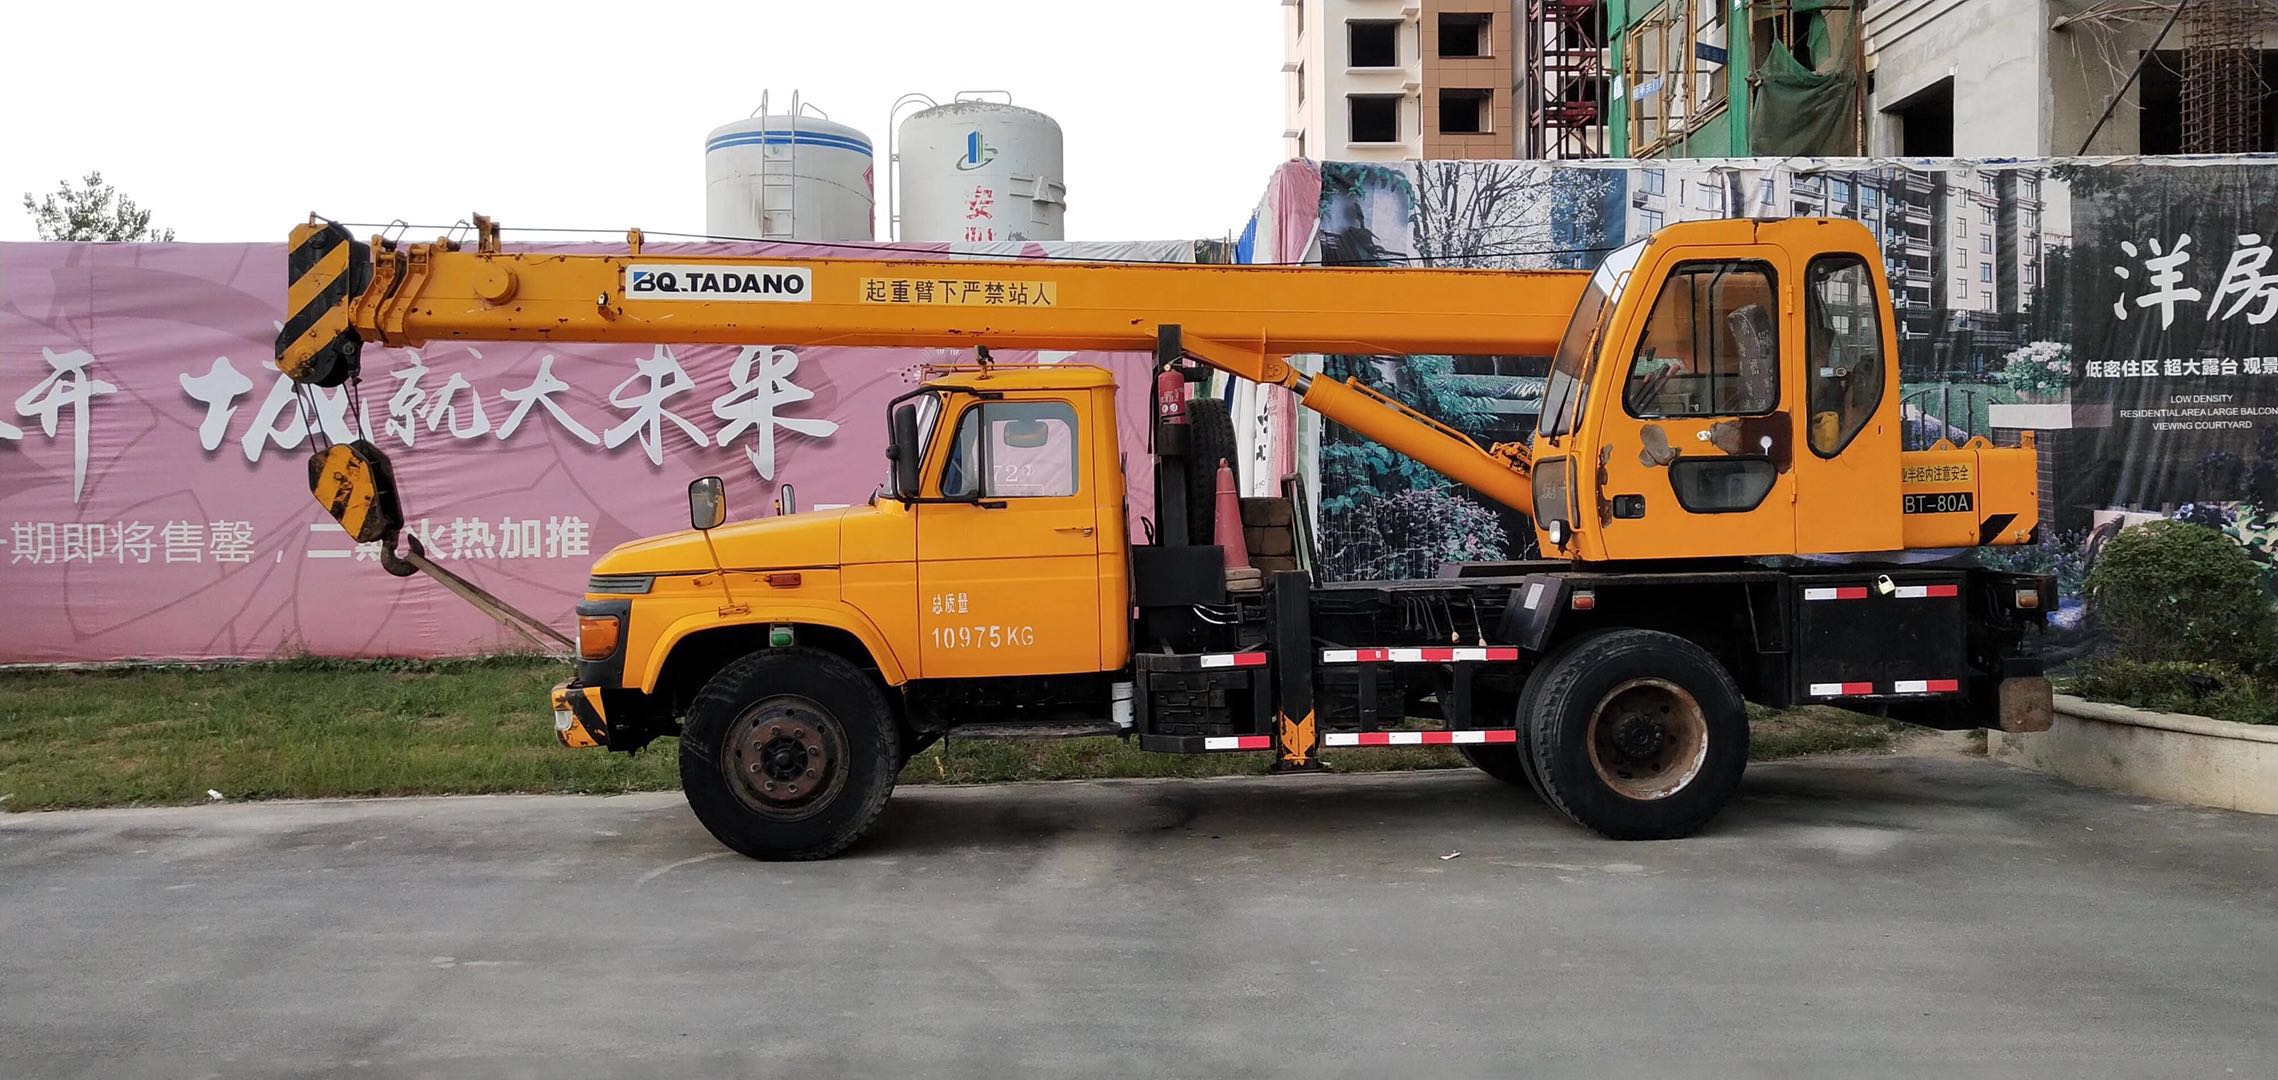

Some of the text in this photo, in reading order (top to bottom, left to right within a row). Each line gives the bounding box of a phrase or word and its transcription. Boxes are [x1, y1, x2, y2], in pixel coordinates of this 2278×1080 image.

[866, 279, 1051, 305] 起重臂下严禁站人
[2114, 233, 2278, 331] 洋房
[2085, 357, 2278, 378] 低密住区 超大露台 观景
[2171, 394, 2233, 404] LOW DENSITY
[2120, 409, 2181, 418] RESIDENTIAL
[2182, 408, 2206, 417] AREA
[2207, 408, 2239, 416] LARGE
[0, 347, 118, 503] 开
[2152, 421, 2252, 431] VIEWING COURTYARD
[1905, 494, 1969, 513] BT-80A
[932, 592, 968, 615] 总质量
